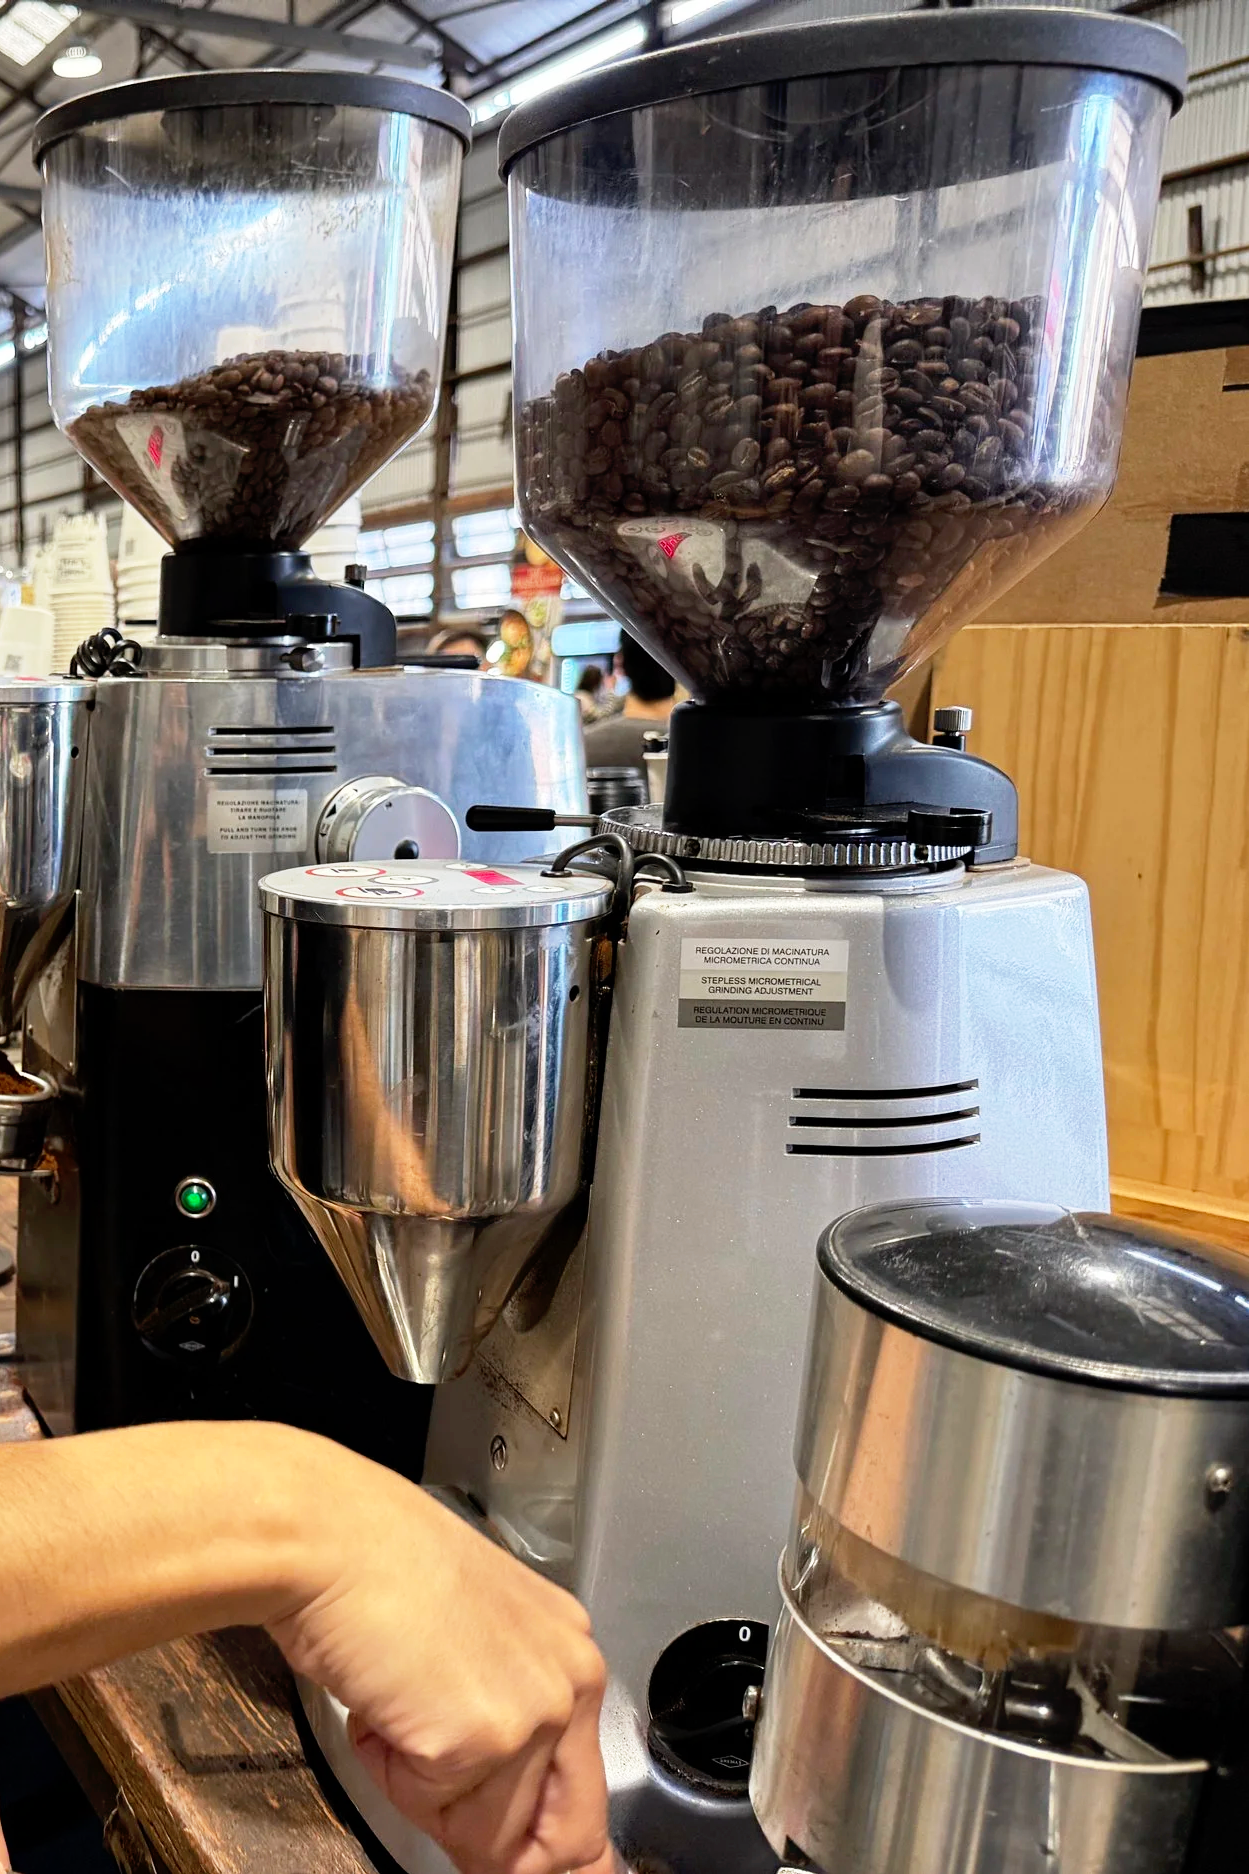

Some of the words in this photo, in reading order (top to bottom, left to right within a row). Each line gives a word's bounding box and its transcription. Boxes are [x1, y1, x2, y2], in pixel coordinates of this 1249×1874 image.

[695, 946, 759, 955] REGOLAZIONE
[761, 947, 770, 955] DI
[772, 947, 830, 956] MACINATURA
[703, 956, 772, 965] MICROMETRICA
[774, 957, 821, 966] CONTINUA
[701, 976, 746, 985] STEPLESS
[748, 977, 821, 987] MICROMETRICAL
[708, 986, 752, 995] GRINDING
[754, 987, 814, 996] ADJUSTMENT
[693, 1006, 750, 1015] REGULATION
[751, 1007, 827, 1016] MICROMETRIQUE
[695, 1016, 707, 1024] DE
[709, 1016, 721, 1024] LA
[722, 1016, 766, 1025] MOUTURE
[769, 1017, 781, 1025] EN
[784, 1017, 824, 1026] CONTINU
[190, 1250, 200, 1263] 0
[738, 1626, 751, 1642] 0
